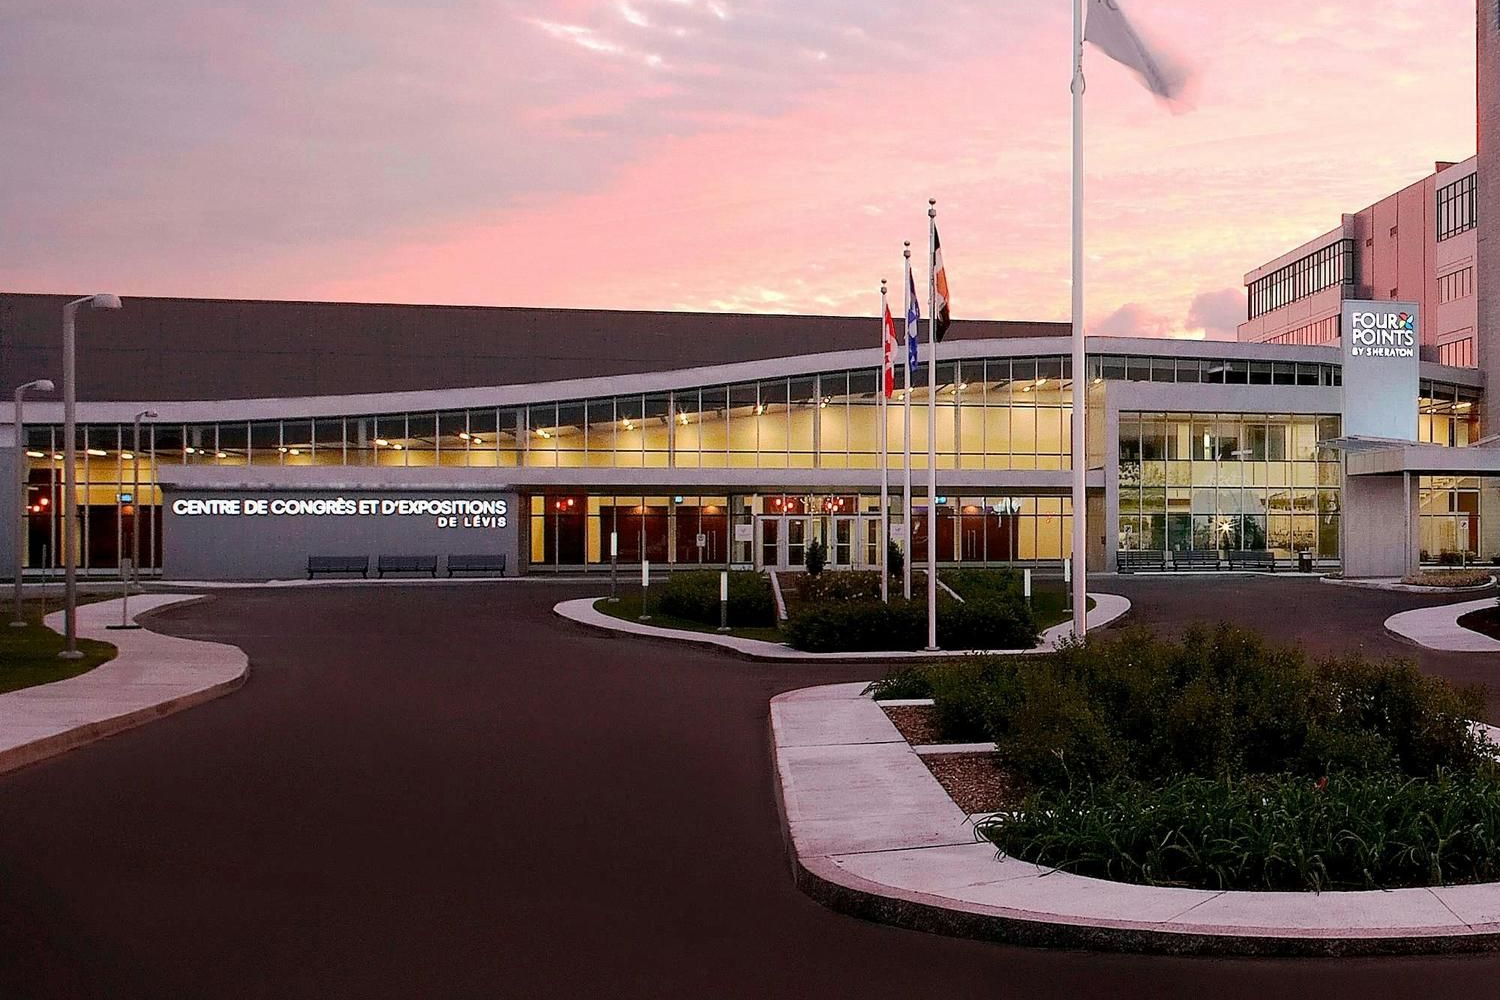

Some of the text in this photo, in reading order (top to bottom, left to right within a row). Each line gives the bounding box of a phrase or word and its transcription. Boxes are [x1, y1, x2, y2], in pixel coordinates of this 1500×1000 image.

[1352, 312, 1399, 329] FOUR
[1352, 328, 1414, 346] POINTS
[1351, 347, 1414, 357] BY SHERATON
[172, 497, 507, 515] CENTRE DE CONGRÈS ET D'EXPOSITIONS
[437, 515, 507, 528] DE LÉVIS
